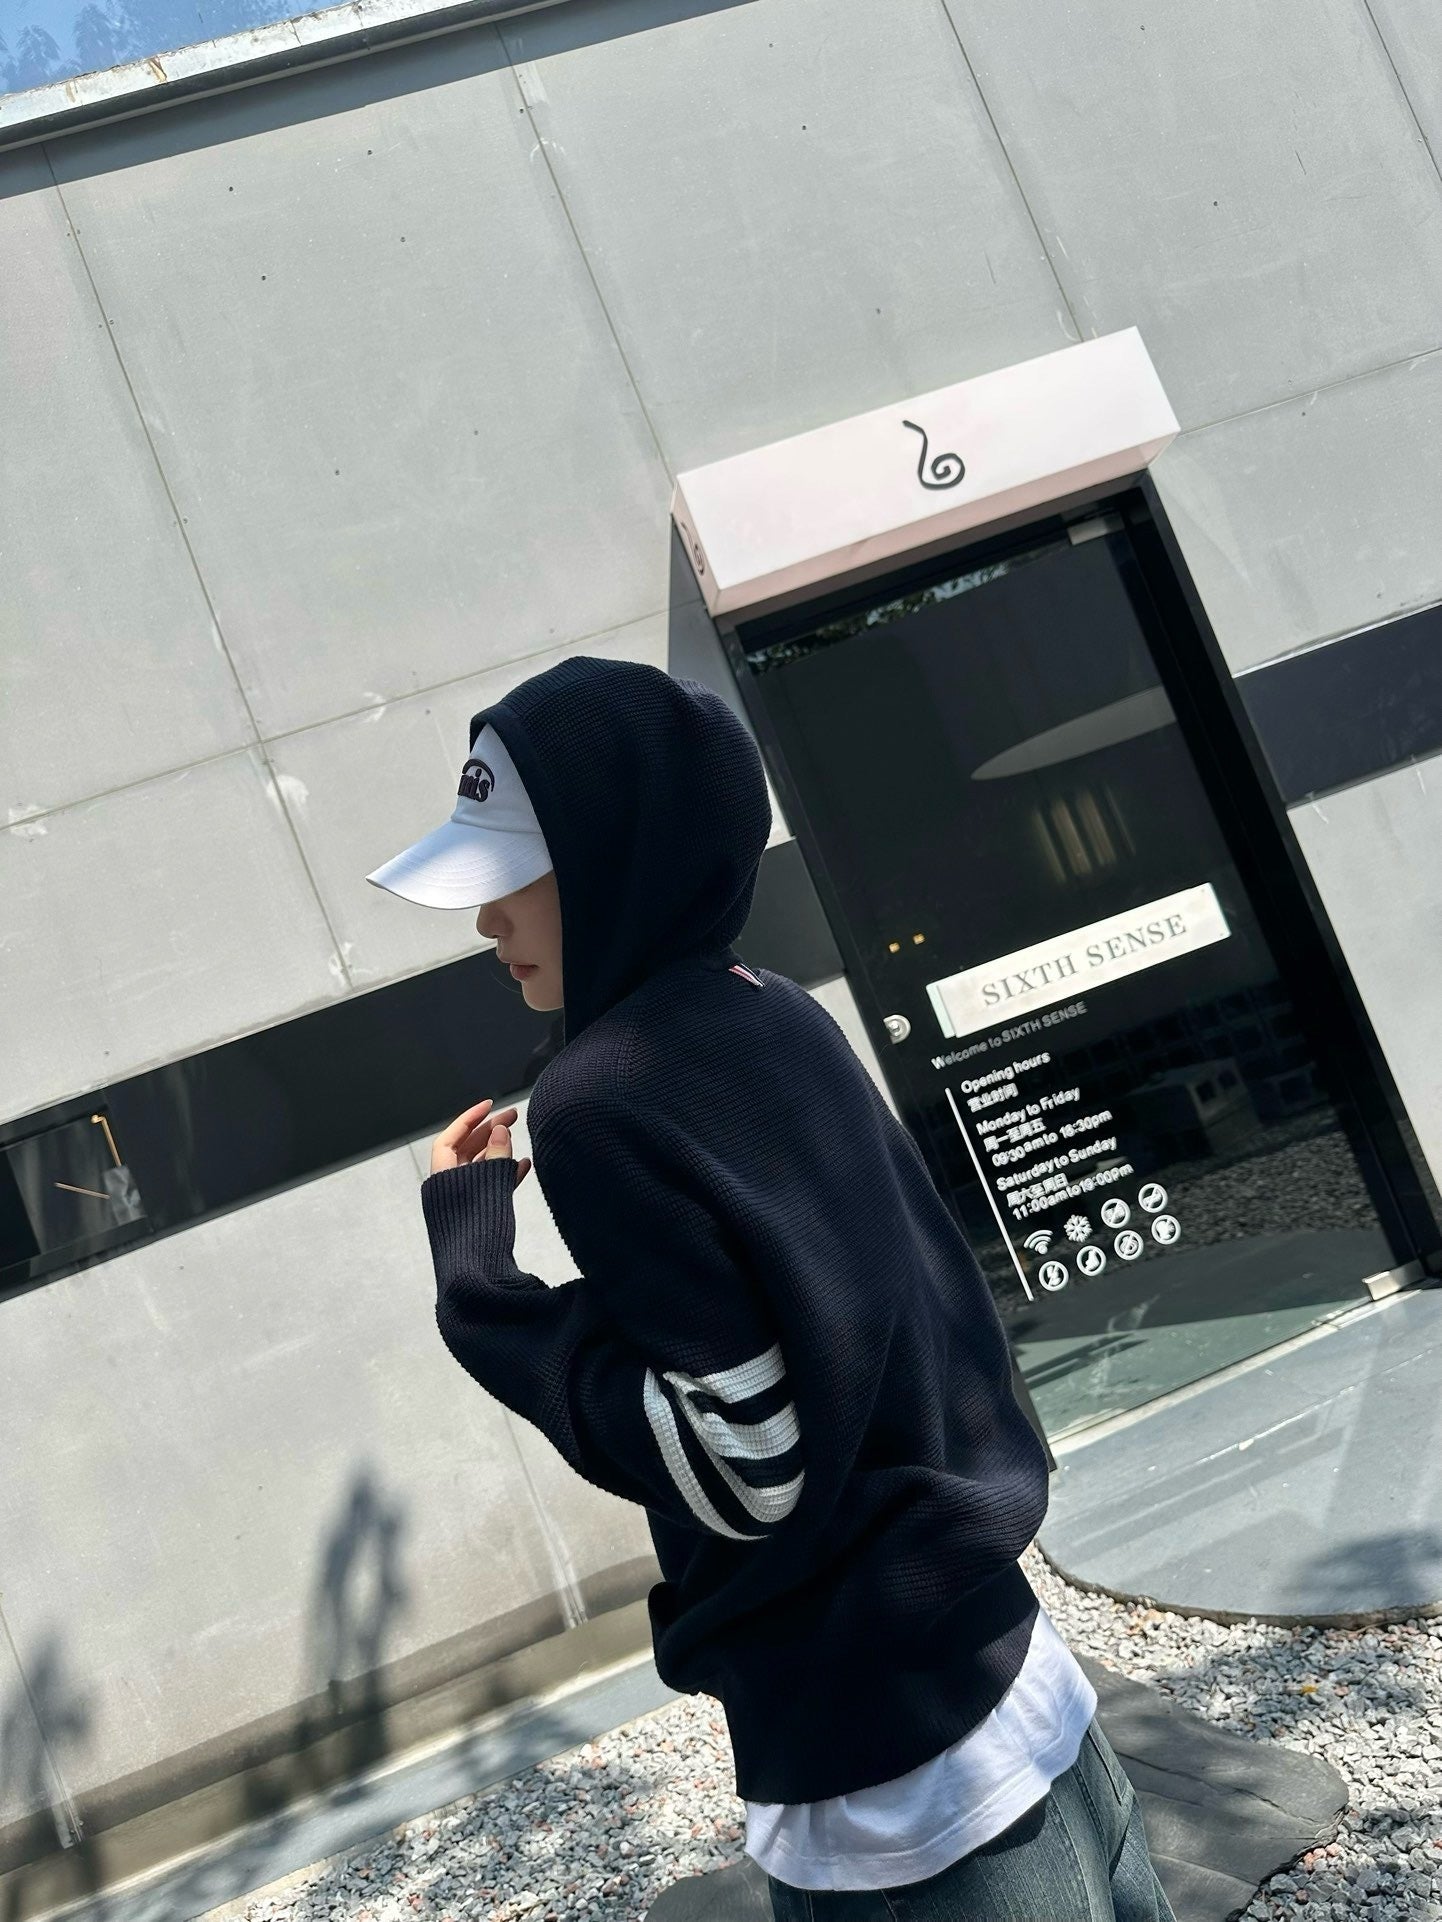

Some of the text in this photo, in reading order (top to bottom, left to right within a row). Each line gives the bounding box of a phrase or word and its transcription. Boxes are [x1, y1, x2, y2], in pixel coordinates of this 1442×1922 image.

[981, 914, 1188, 1006] SIXTH SENSE
[931, 1001, 1087, 1069] Welcome to SIXTH SENSE
[961, 1053, 1050, 1093] Opening hours
[967, 1083, 1018, 1112] 营业时间
[976, 1088, 1080, 1135] Monday to Friday
[984, 1118, 1046, 1152] 周一至周五
[1043, 1133, 1058, 1145] to
[996, 1137, 1116, 1191] Saturday to Sunday
[1007, 1173, 1069, 1207] 周六至周日
[1066, 1185, 1081, 1197] to
